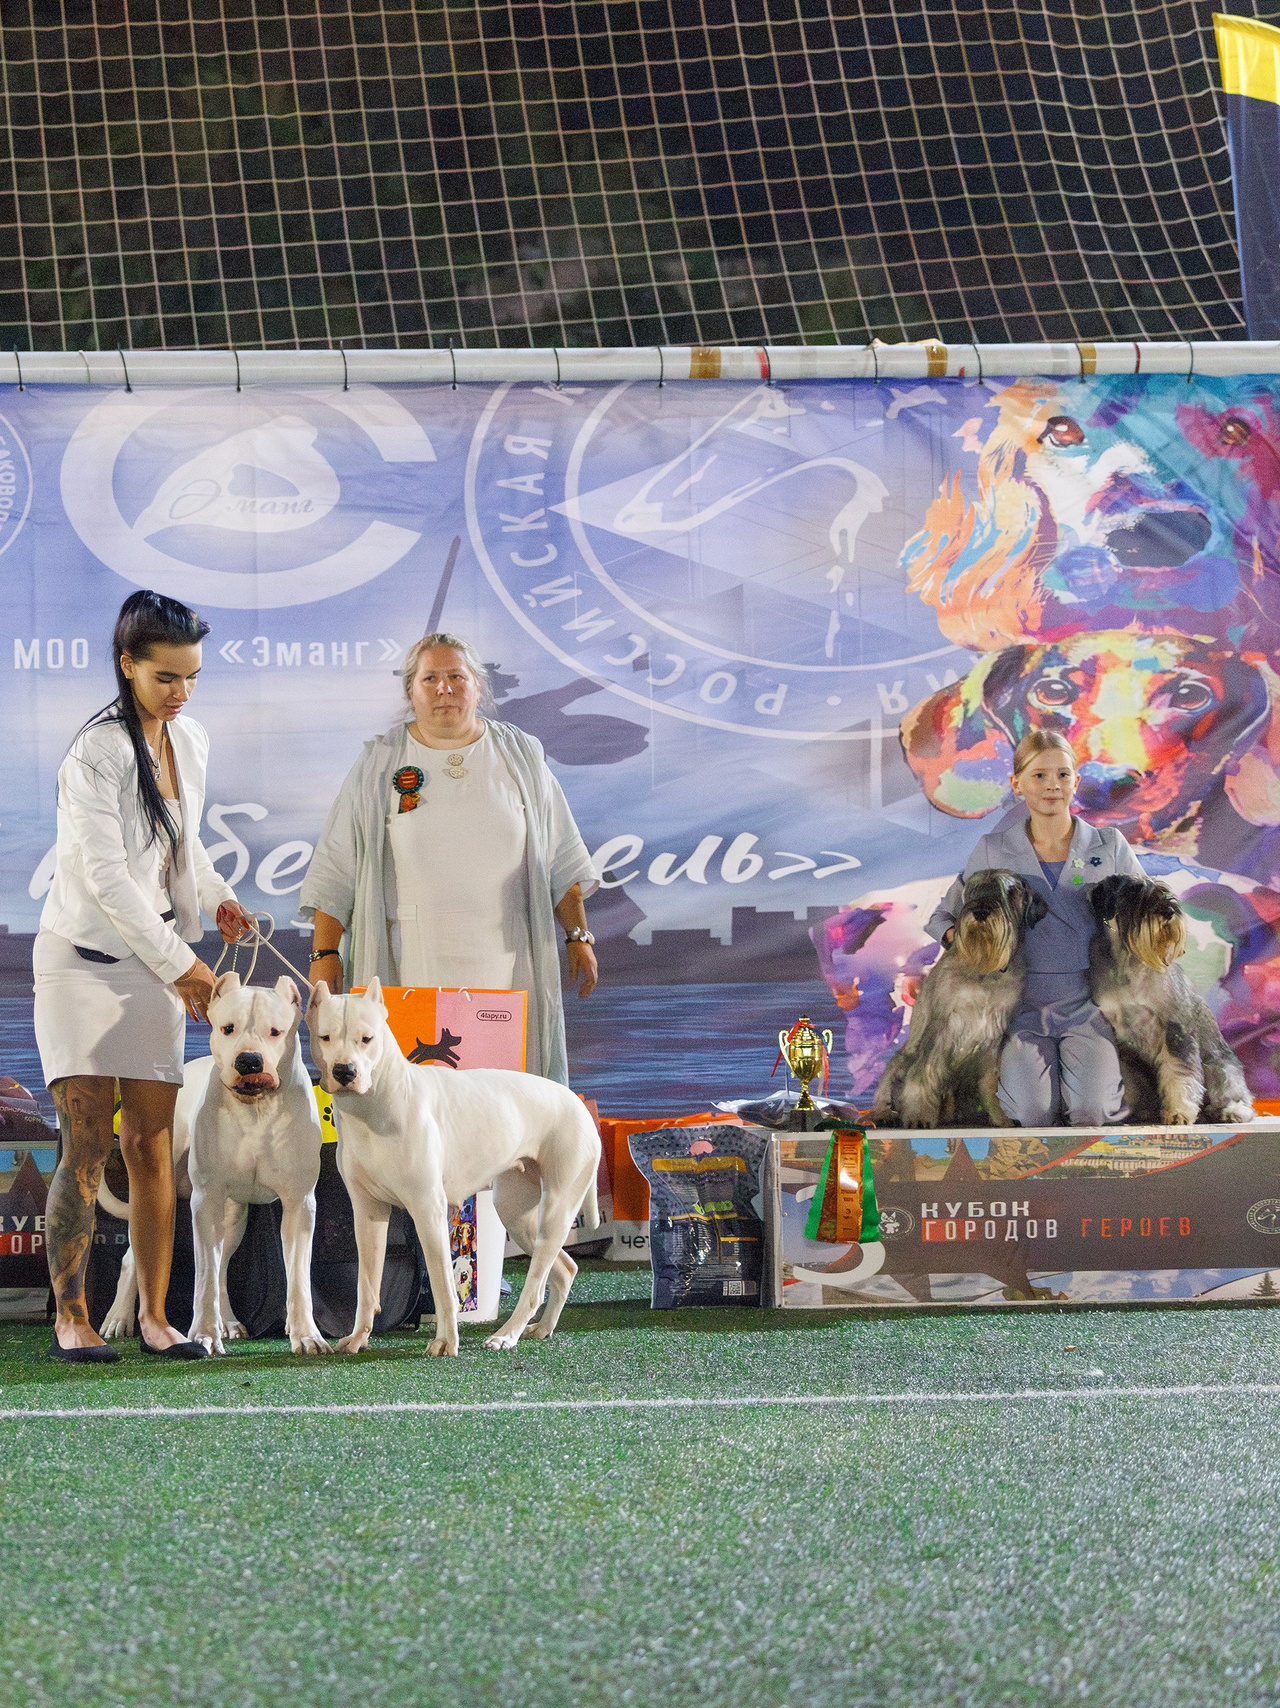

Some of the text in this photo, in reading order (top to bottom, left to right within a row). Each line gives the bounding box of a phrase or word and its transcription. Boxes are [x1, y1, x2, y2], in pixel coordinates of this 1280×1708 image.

[496, 434, 789, 716] РОССИЙСКАЯ
[480, 1012, 507, 1020] 4lapy.ru
[922, 1200, 1030, 1219] КУБОК
[925, 1216, 1192, 1243] ГОРОДОВ ГЕРОЕВ
